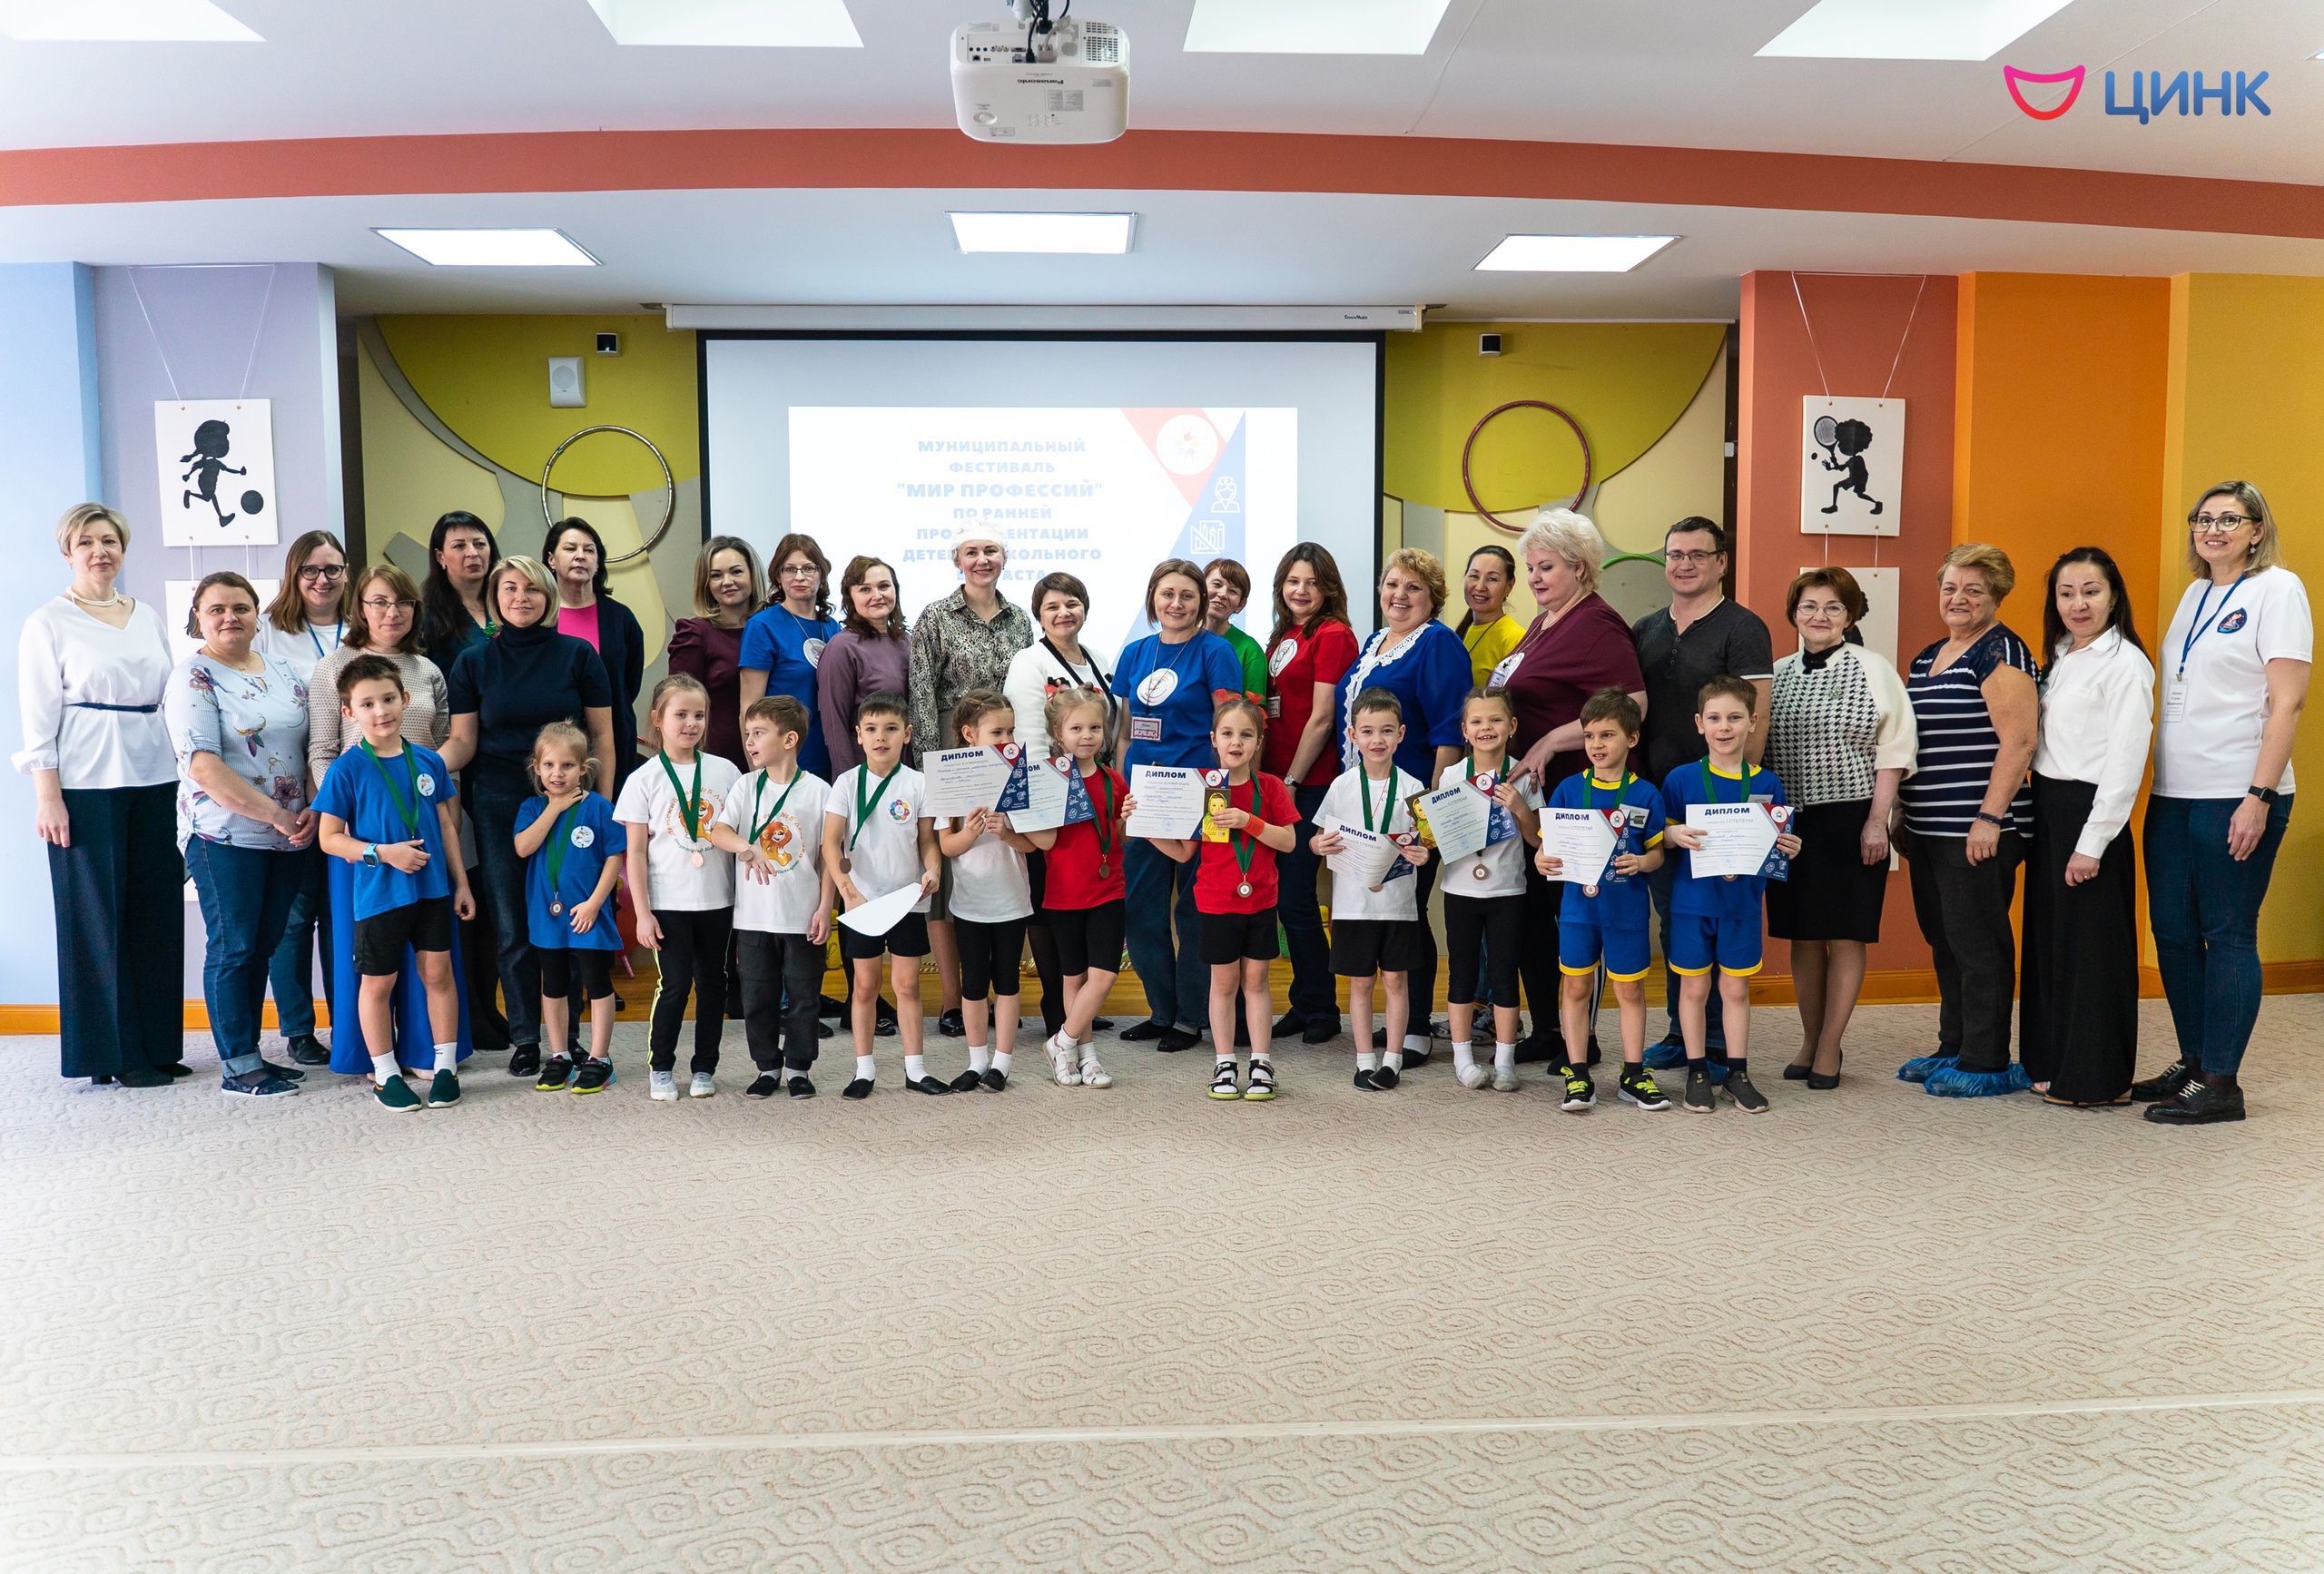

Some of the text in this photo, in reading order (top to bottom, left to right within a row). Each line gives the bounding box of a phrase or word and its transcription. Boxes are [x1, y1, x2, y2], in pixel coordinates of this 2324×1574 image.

[918, 438, 1086, 454] МУНИЦИПАЛЬНЫЙ
[949, 461, 1055, 474] ФЕСТИВАЛЬ
[897, 478, 1103, 497] "МИР ПРОФЕССИЙ"
[953, 504, 1052, 519] ПО РАННЕЙ
[1009, 548, 1102, 561] КОЛЬНОГО
[940, 750, 984, 762] ДИПЛОМ
[1145, 770, 1187, 779] ДИПЛОМ
[1431, 786, 1461, 804] ДИПЛОМ
[1555, 812, 1590, 821] ДИПЛОМ
[1704, 807, 1750, 816] ДИПЛОМ
[1339, 823, 1377, 842] ДИПЛОМ
